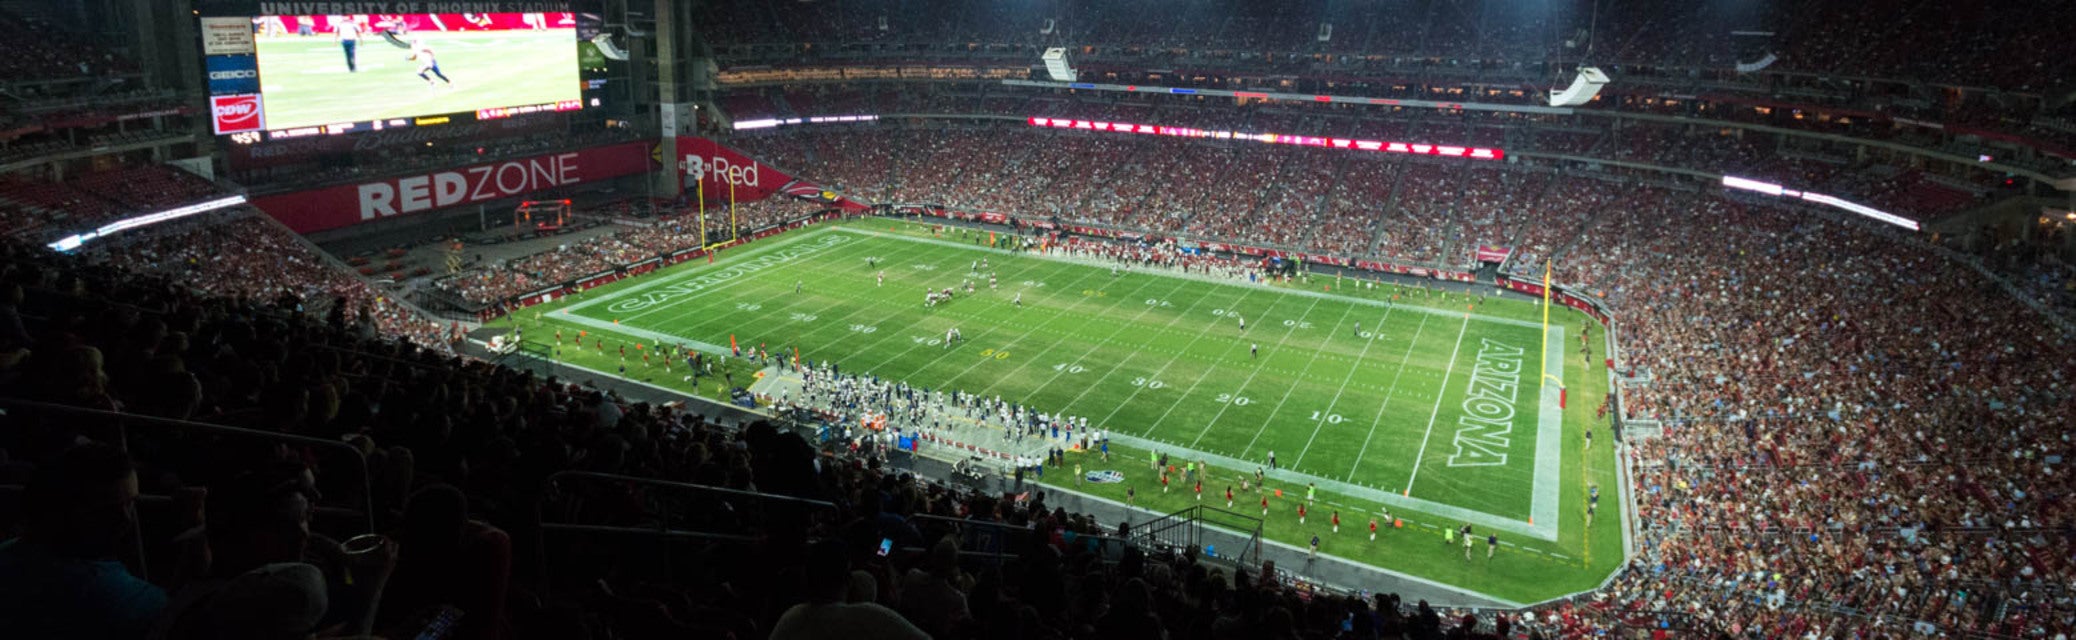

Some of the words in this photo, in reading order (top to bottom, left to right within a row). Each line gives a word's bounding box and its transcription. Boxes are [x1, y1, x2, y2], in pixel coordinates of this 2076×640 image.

[259, 3, 389, 15] UNIVERSITY
[395, 2, 419, 14] OF
[427, 2, 500, 13] PHOENIX
[507, 2, 570, 13] STADIUM
[209, 69, 257, 80] GEICO
[215, 104, 252, 117] CDW
[357, 152, 581, 221] REDZONE
[607, 235, 851, 313] CARDINALS
[980, 349, 1010, 360] 50
[1052, 362, 1085, 374] 40
[1130, 376, 1165, 390] 30
[1215, 392, 1250, 406] 20
[1446, 338, 1525, 467] ARIZONA
[1308, 411, 1343, 424] 10
